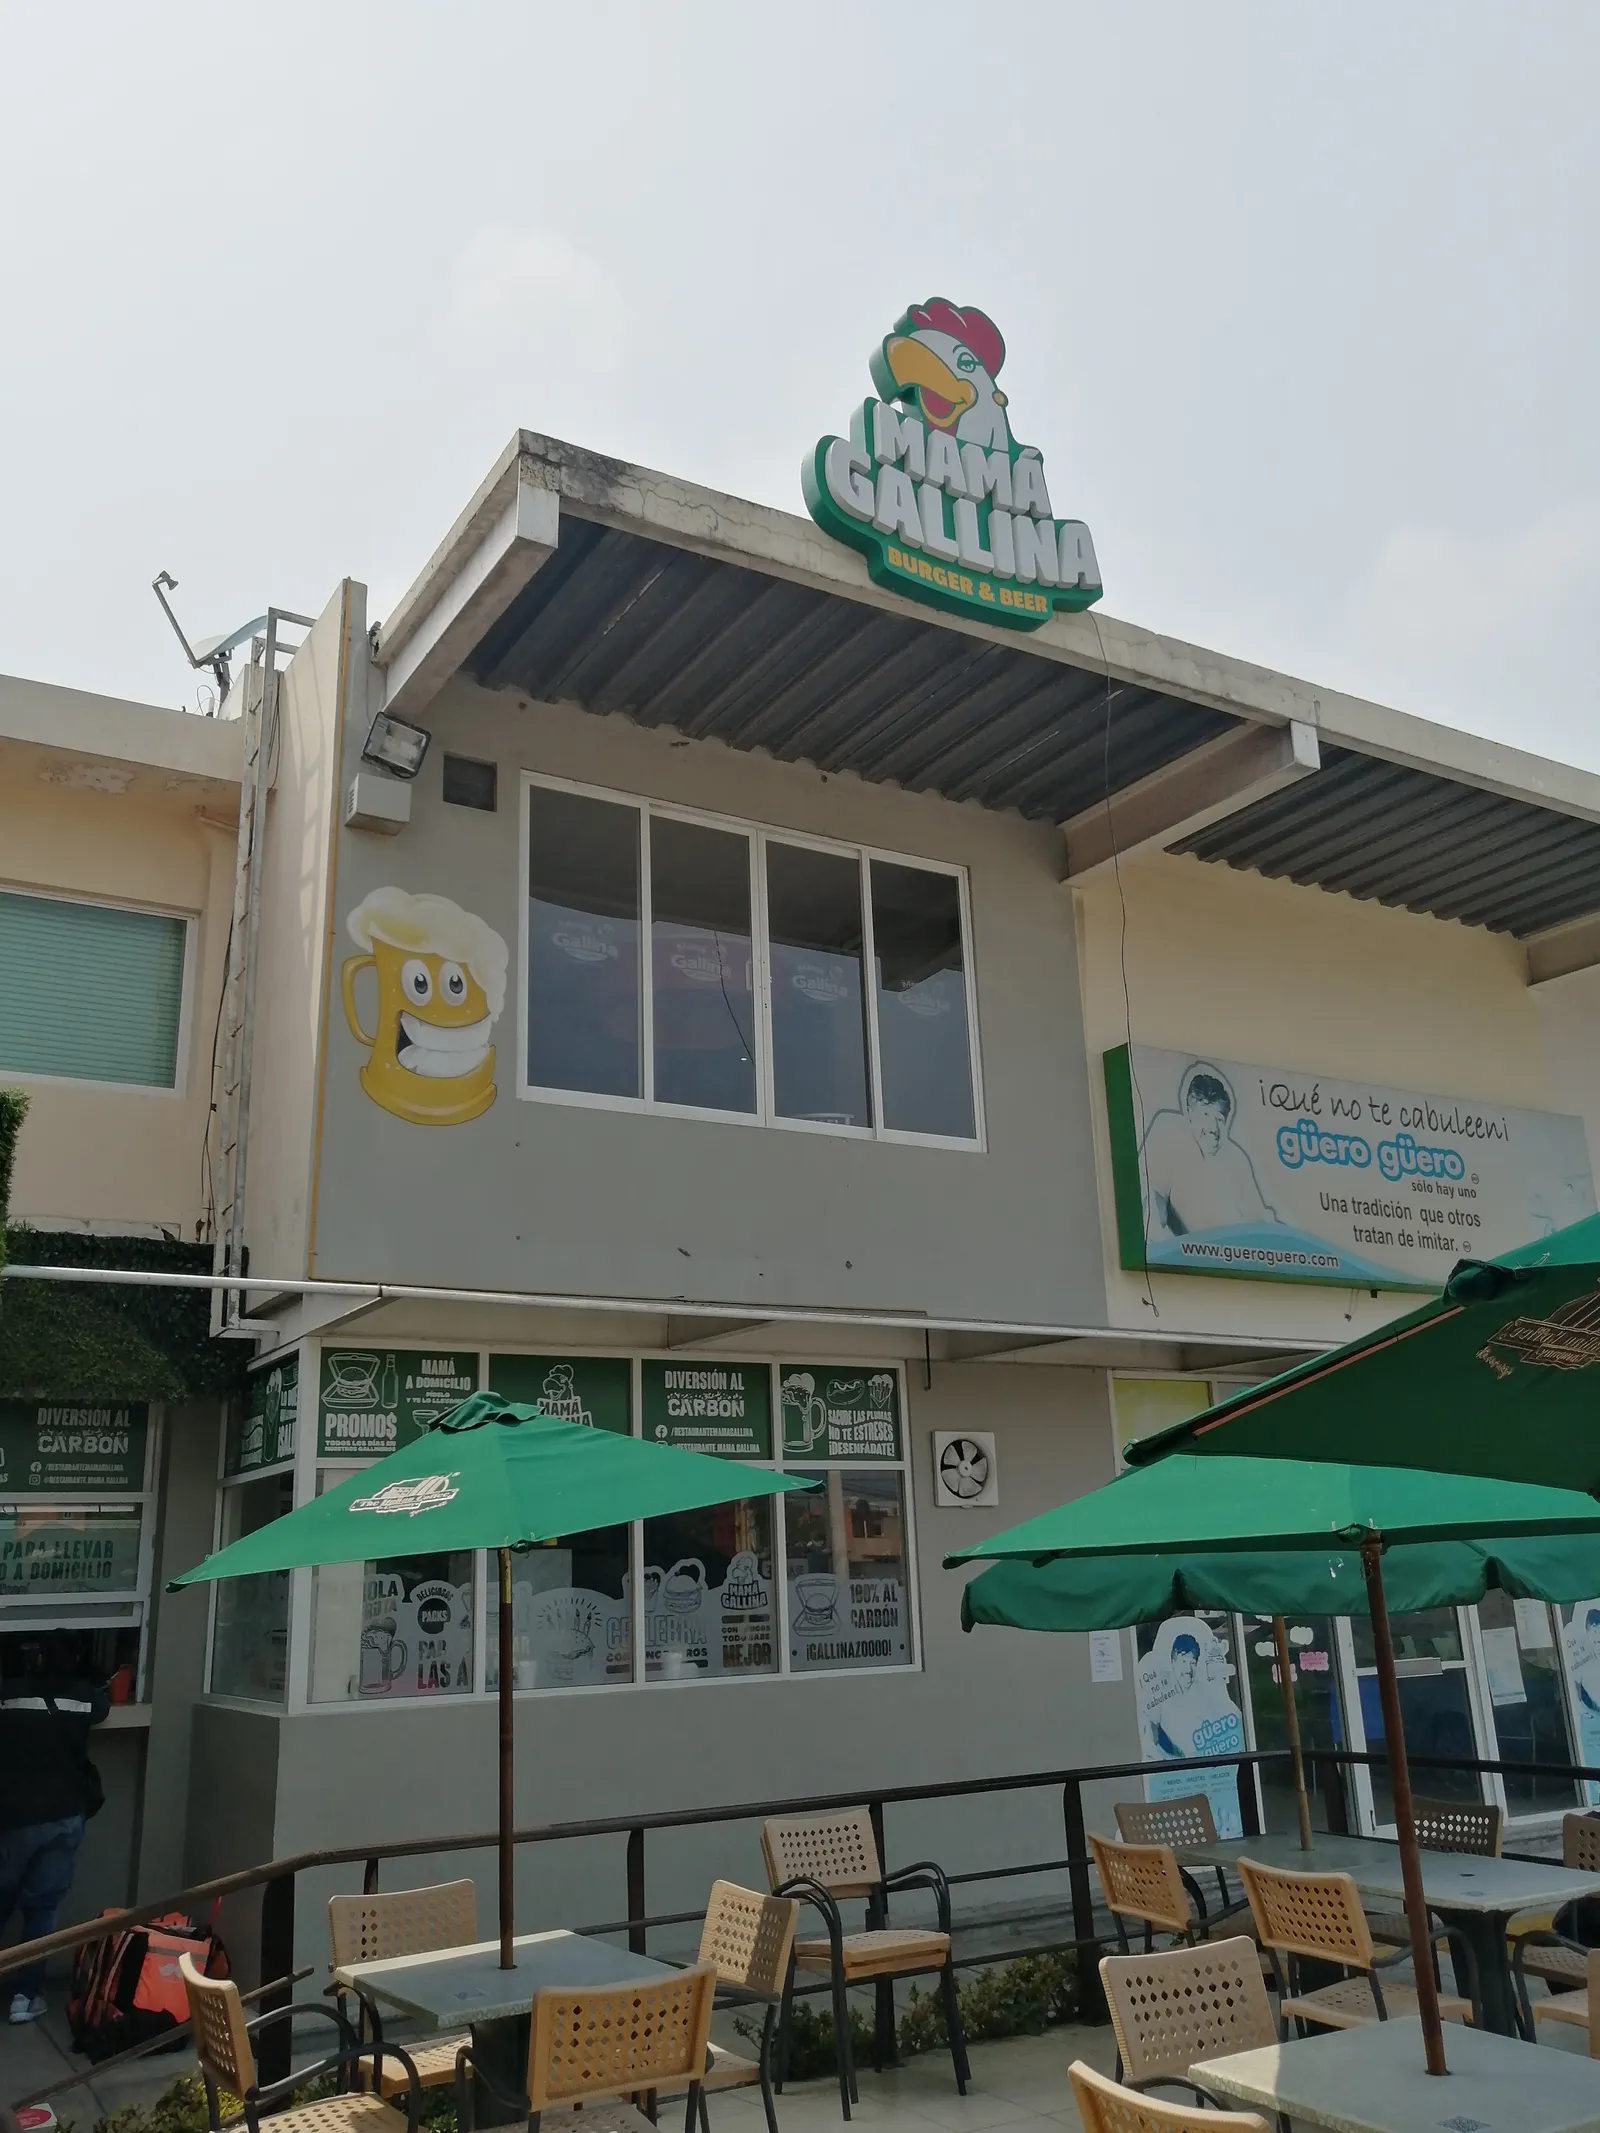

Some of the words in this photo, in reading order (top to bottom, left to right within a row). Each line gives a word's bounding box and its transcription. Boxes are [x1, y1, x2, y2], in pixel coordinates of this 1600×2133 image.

[825, 438, 1101, 590] GALLINA
[888, 546, 973, 595] BURGER
[979, 581, 995, 603] &
[1000, 587, 1047, 613] BEER
[1330, 1096, 1361, 1120] no
[1368, 1095, 1392, 1126] te
[1277, 1119, 1372, 1169] güero
[1377, 1133, 1465, 1181] güero
[1411, 1179, 1433, 1194] sólo
[1436, 1181, 1455, 1200] hay
[1457, 1186, 1477, 1199] uno
[1319, 1192, 1348, 1214] Una
[1351, 1197, 1413, 1220] tradición
[1419, 1207, 1444, 1226] que
[1448, 1210, 1481, 1228] otros
[1353, 1224, 1394, 1246] tratan
[1398, 1229, 1414, 1248] de
[1417, 1230, 1459, 1252] imitar.
[1180, 1241, 1340, 1269] www.gueroguero.com
[405, 1375, 413, 1389] A
[416, 1376, 471, 1391] DOMICILIO
[664, 1368, 727, 1390] DIVERSIÓN
[730, 1372, 745, 1390] AL
[37, 1406, 111, 1426] DIVERSIÓN
[114, 1409, 132, 1427] AL
[853, 1410, 866, 1424] LAS
[828, 1424, 840, 1440] NO
[842, 1428, 852, 1441] TE
[853, 1421, 894, 1442] ESTRESES
[13, 1562, 23, 1580] A
[30, 1560, 113, 1580] DOMICILIO
[883, 1583, 898, 1603] AL
[421, 1610, 449, 1623] PACKS
[722, 1643, 772, 1668] MEJOR
[1192, 1713, 1238, 1751] güero
